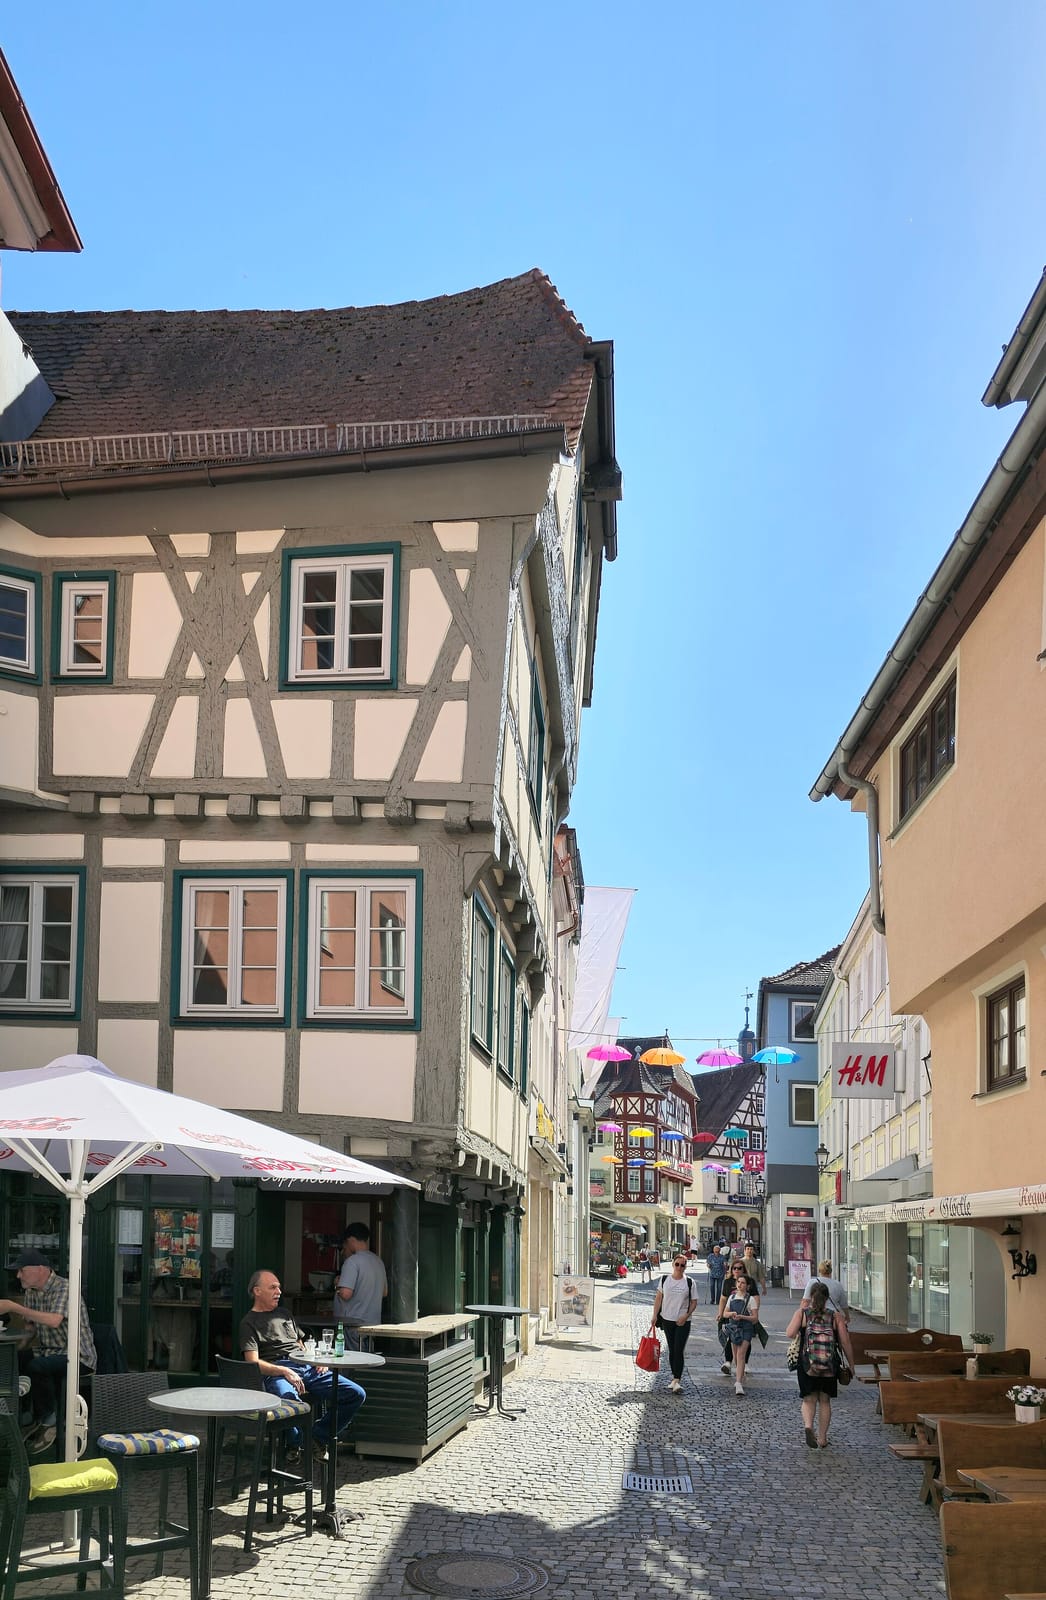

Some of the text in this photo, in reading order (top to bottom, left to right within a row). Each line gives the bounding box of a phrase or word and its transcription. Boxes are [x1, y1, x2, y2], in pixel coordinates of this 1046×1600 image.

[838, 1055, 889, 1087] H&M
[748, 1154, 761, 1169] T
[1018, 1186, 1046, 1212] Regio
